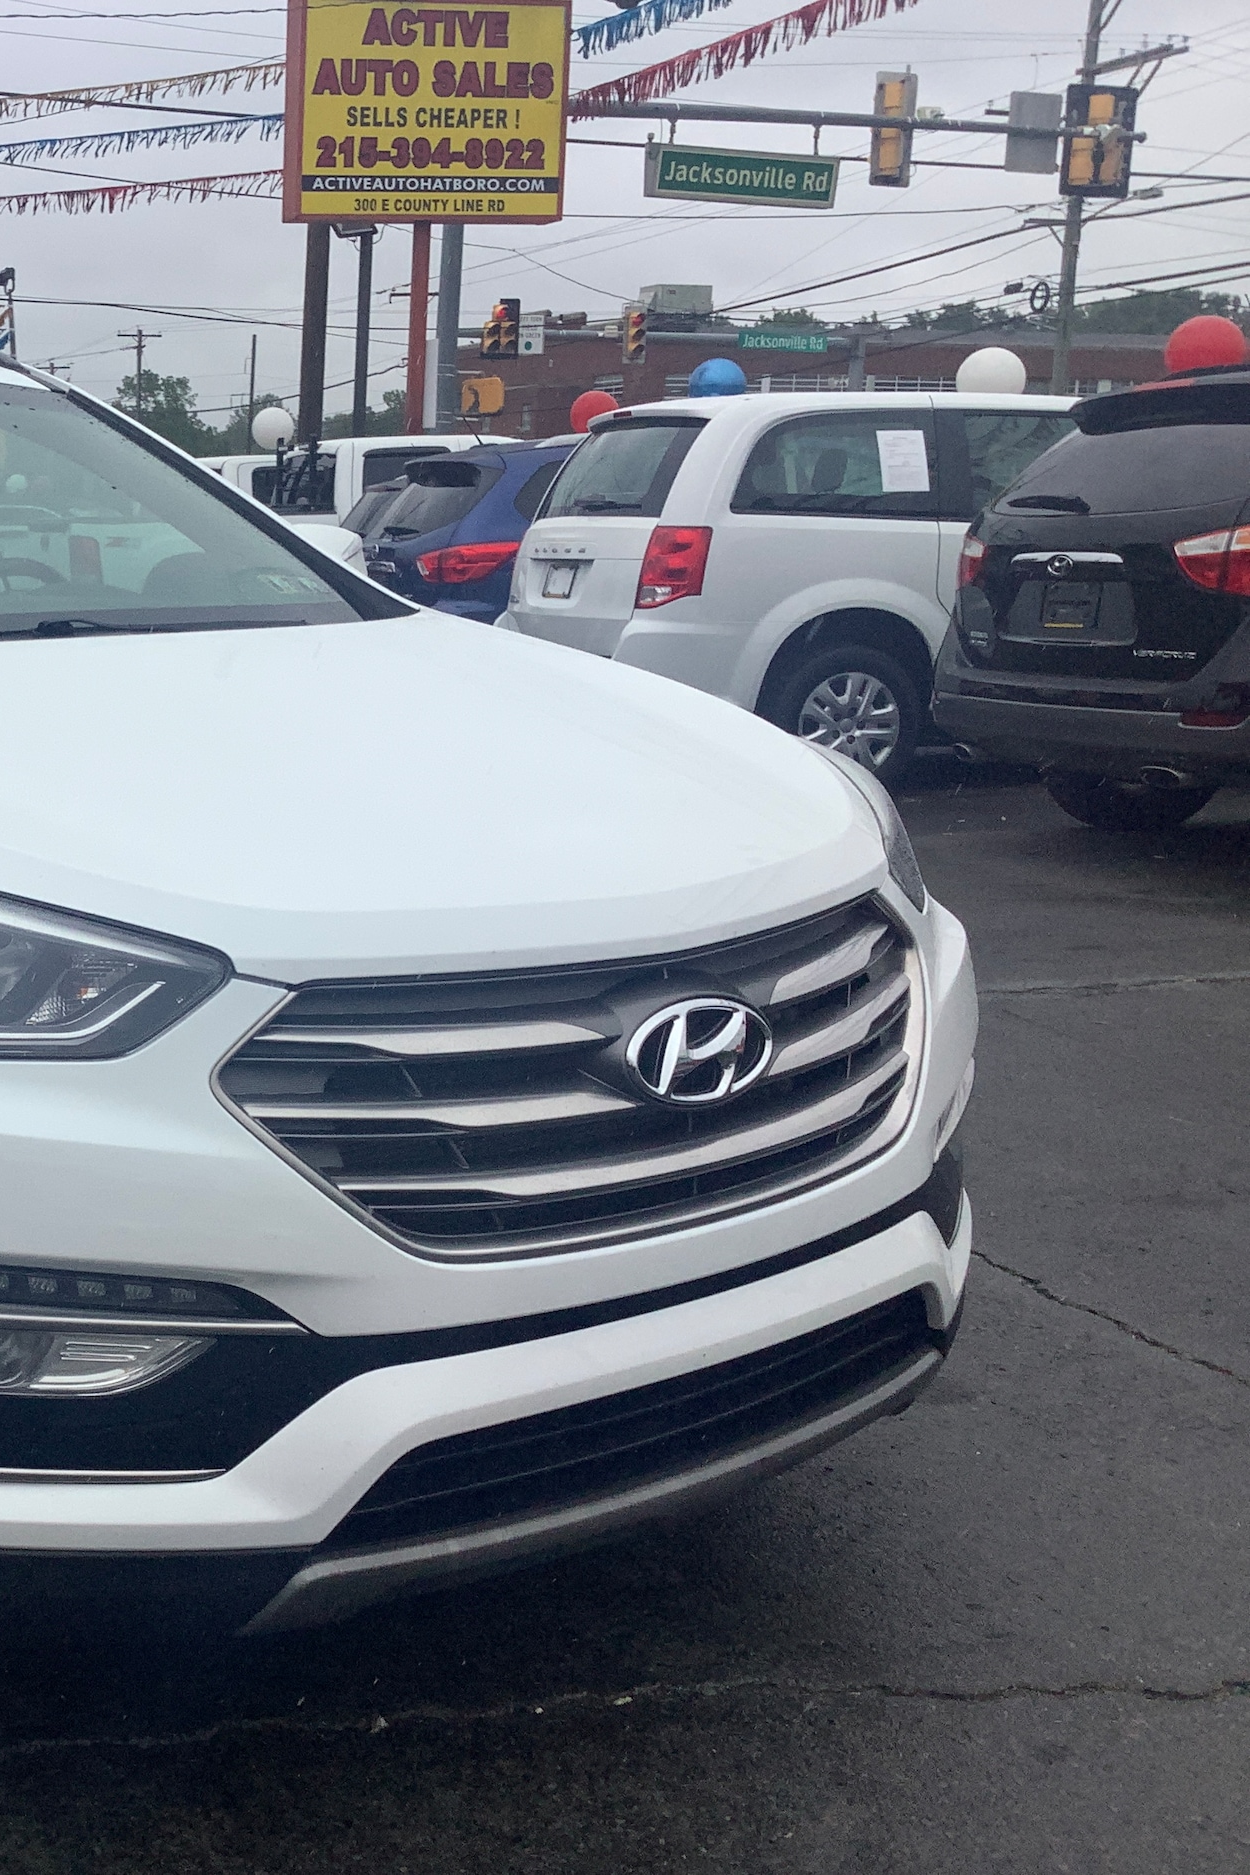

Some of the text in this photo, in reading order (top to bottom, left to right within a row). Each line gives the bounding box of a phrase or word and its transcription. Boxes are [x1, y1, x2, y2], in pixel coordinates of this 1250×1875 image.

[361, 8, 510, 48] ACTIVE
[311, 58, 555, 99] AUTO SALES
[346, 106, 408, 129] SELLS
[415, 107, 508, 129] CHEAPER
[315, 136, 546, 170] 215-394-8922
[312, 176, 546, 192] ACTIVEAUTOHATBORO.COM
[664, 161, 829, 193] Jacksonville Rd
[354, 198, 505, 212] 300 E COUNTY LINE RD
[742, 333, 824, 350] Jacksonville Rd
